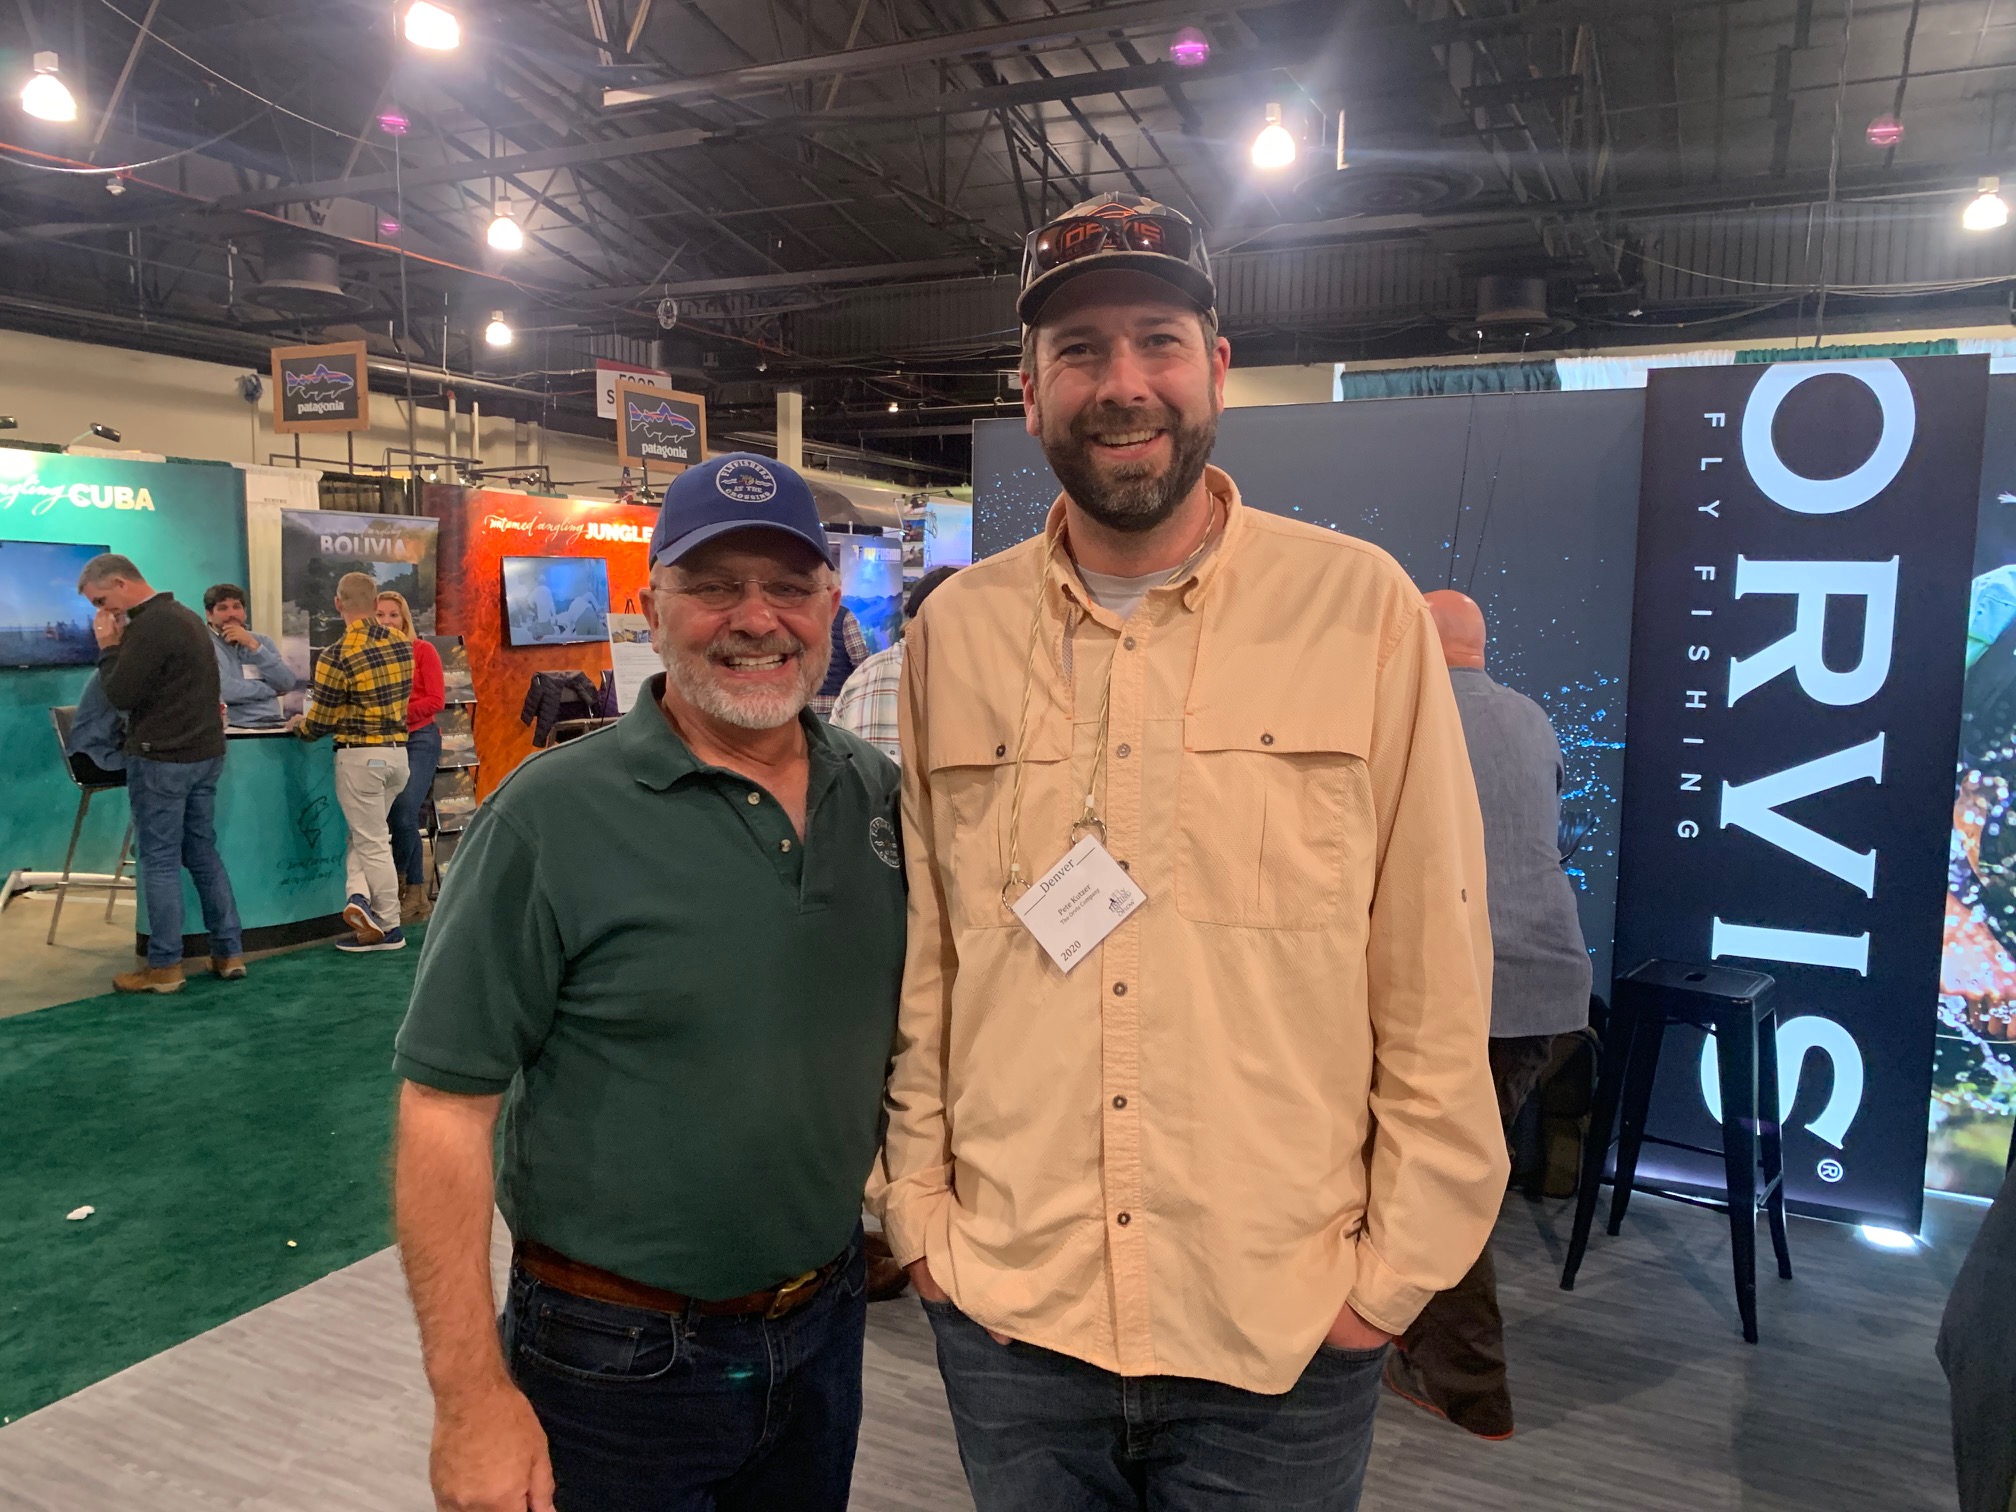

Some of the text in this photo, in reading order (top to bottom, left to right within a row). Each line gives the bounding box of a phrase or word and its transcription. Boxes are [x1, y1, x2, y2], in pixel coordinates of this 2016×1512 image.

[297, 400, 344, 414] patagonia
[641, 442, 687, 458] patagonia
[68, 482, 155, 511] CUBA
[746, 485, 762, 493] THE
[535, 516, 587, 545] angling
[320, 535, 408, 556] BOLIVIA
[1677, 411, 1726, 839] FLY FISHING
[1700, 358, 1916, 1149] ORVIS
[1039, 859, 1075, 893] Denver
[1057, 884, 1092, 916] Pete Kutzer
[1060, 888, 1101, 925] The Orvis Company
[1060, 940, 1082, 962] 2020
